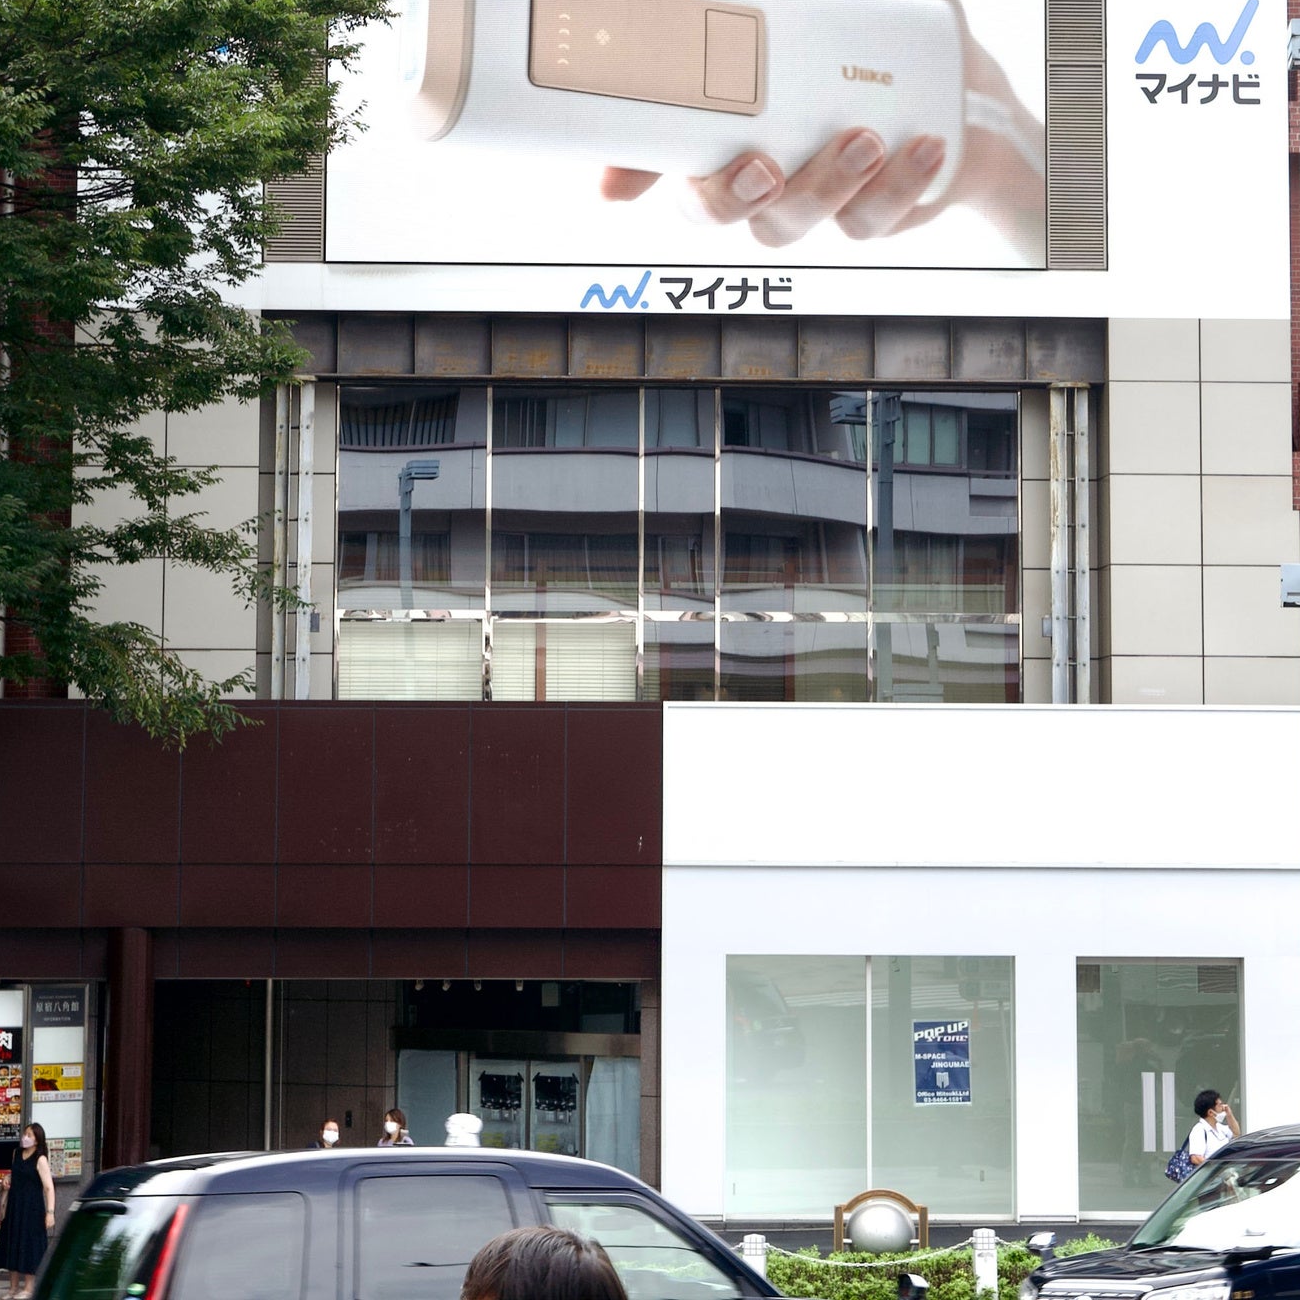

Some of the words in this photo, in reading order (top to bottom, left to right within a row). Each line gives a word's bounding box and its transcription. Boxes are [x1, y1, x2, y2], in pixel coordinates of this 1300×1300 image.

[841, 64, 893, 87] Ulike
[1135, 73, 1261, 105] マイナビ
[659, 277, 793, 310] マイナビ
[914, 1026, 945, 1041] POP
[947, 1021, 969, 1034] UP
